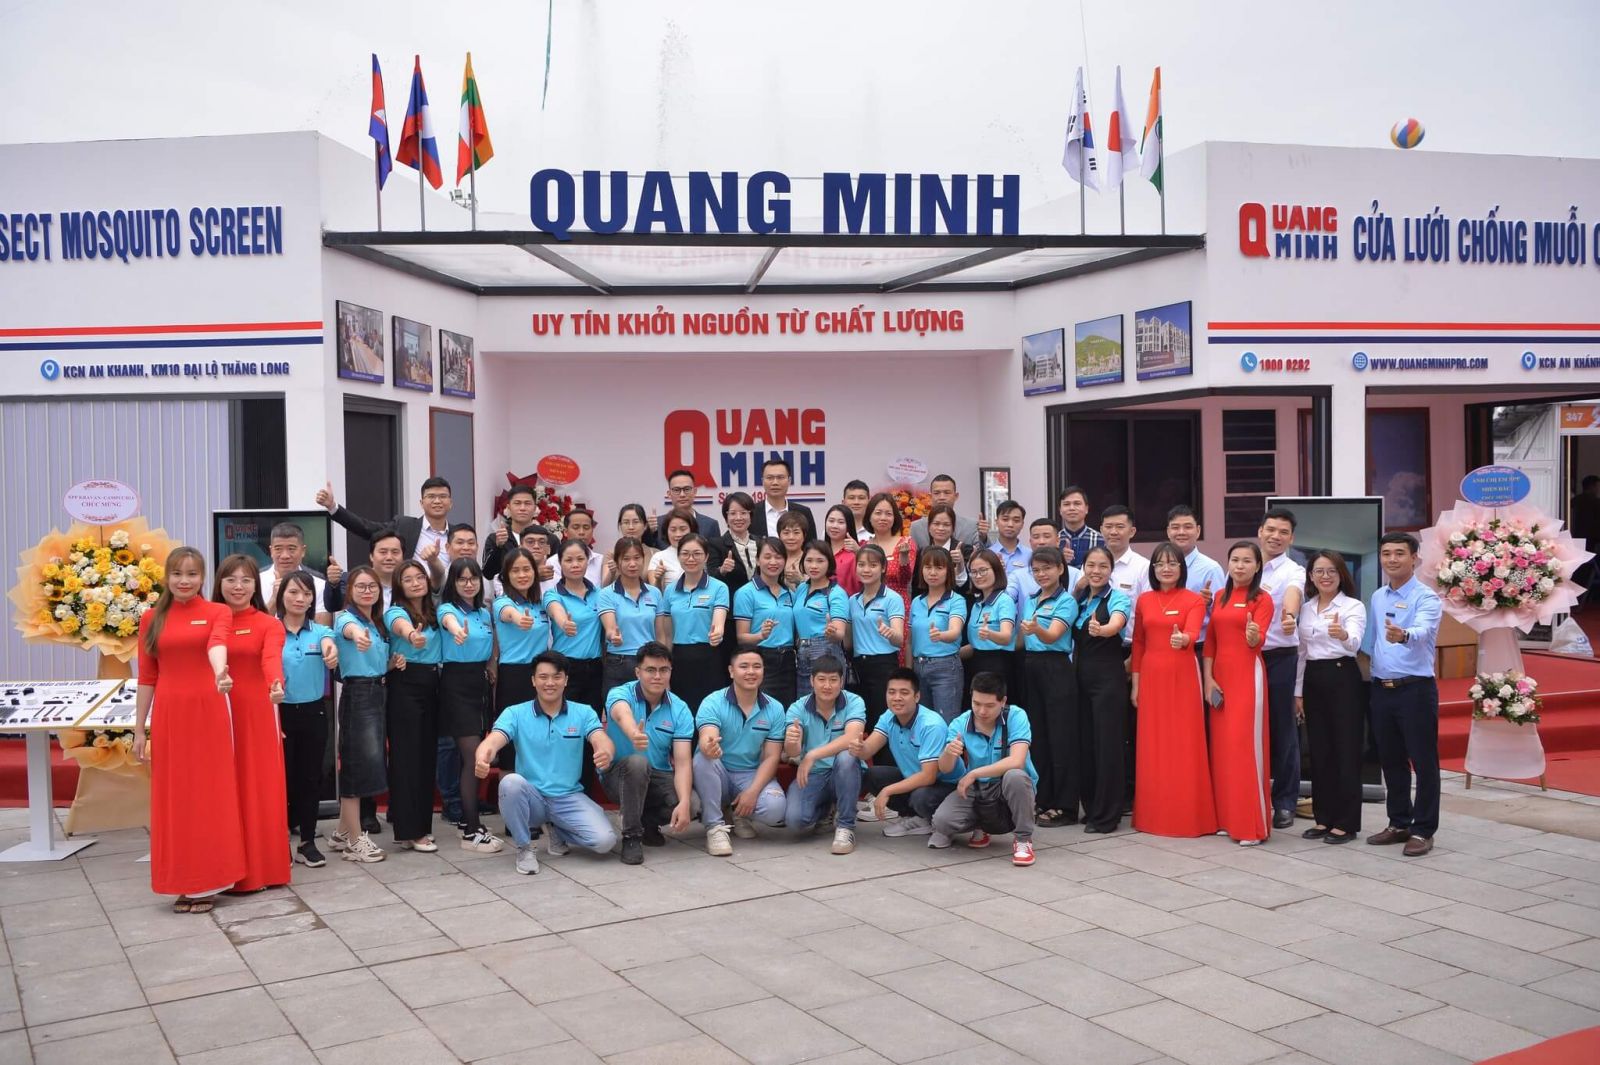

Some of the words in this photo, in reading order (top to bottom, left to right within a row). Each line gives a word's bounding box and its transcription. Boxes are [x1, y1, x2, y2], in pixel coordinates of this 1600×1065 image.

[530, 168, 791, 241] QUANG
[823, 172, 1020, 235] MINH
[60, 208, 181, 264] MOSQUITO
[189, 206, 283, 257] SCREEN
[1275, 233, 1338, 260] MINH
[1353, 199, 1396, 261] CỬA
[1404, 206, 1450, 262] LƯỚI
[1458, 205, 1527, 263] CHỐNG
[1534, 205, 1586, 265] MUỖI
[532, 313, 564, 336] UY
[570, 309, 610, 336] TÍN
[617, 305, 675, 336] KHỞI
[683, 306, 769, 335] NGUỒN
[776, 307, 809, 334] TỪ
[815, 304, 876, 333] CHẤT
[884, 308, 964, 337] LƯỢNG
[63, 365, 86, 379] KCN
[89, 364, 104, 378] AN
[151, 363, 180, 376] KM10
[183, 362, 203, 379] ĐẠI
[205, 360, 218, 379] LỘ
[221, 361, 257, 376] THĂNG
[260, 362, 290, 375] LONG
[1370, 357, 1489, 370] WWW.QUANGMINHPRO.COM
[1539, 357, 1556, 369] KCN
[1559, 357, 1571, 369] AN
